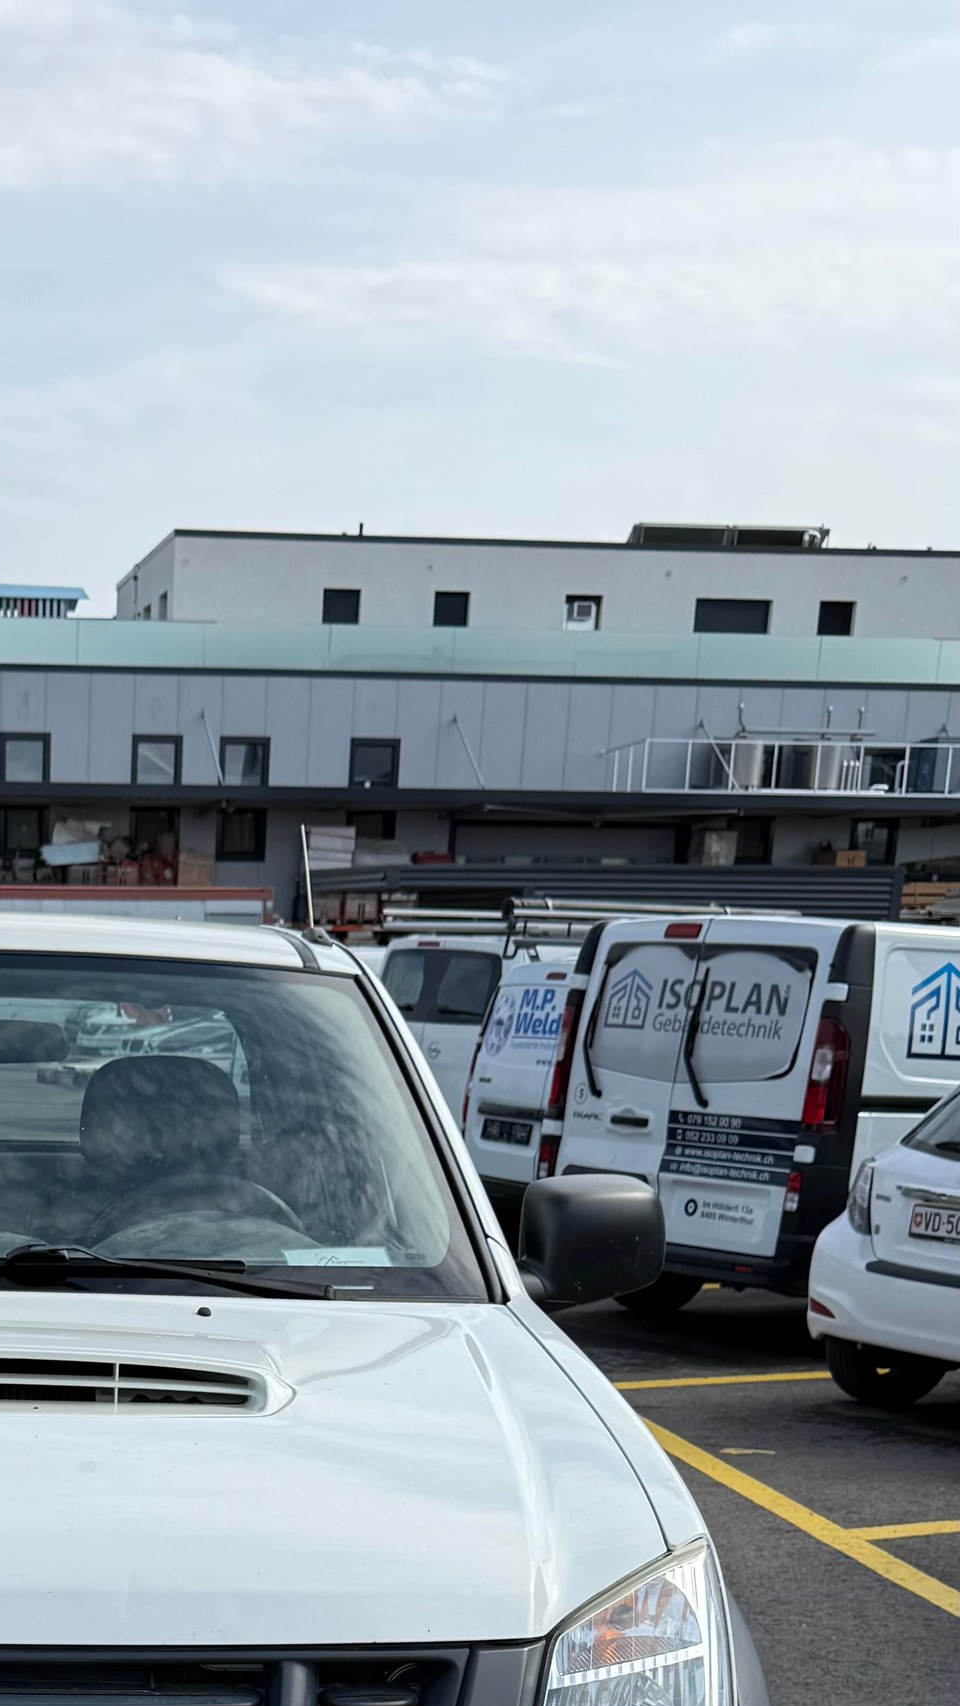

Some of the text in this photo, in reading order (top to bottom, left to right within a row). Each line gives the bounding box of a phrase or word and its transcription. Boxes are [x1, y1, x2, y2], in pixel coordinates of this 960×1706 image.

[520, 988, 556, 1011] M.P.
[657, 978, 789, 1016] ISOPLAN
[652, 1012, 783, 1040] Gebdetechnik
